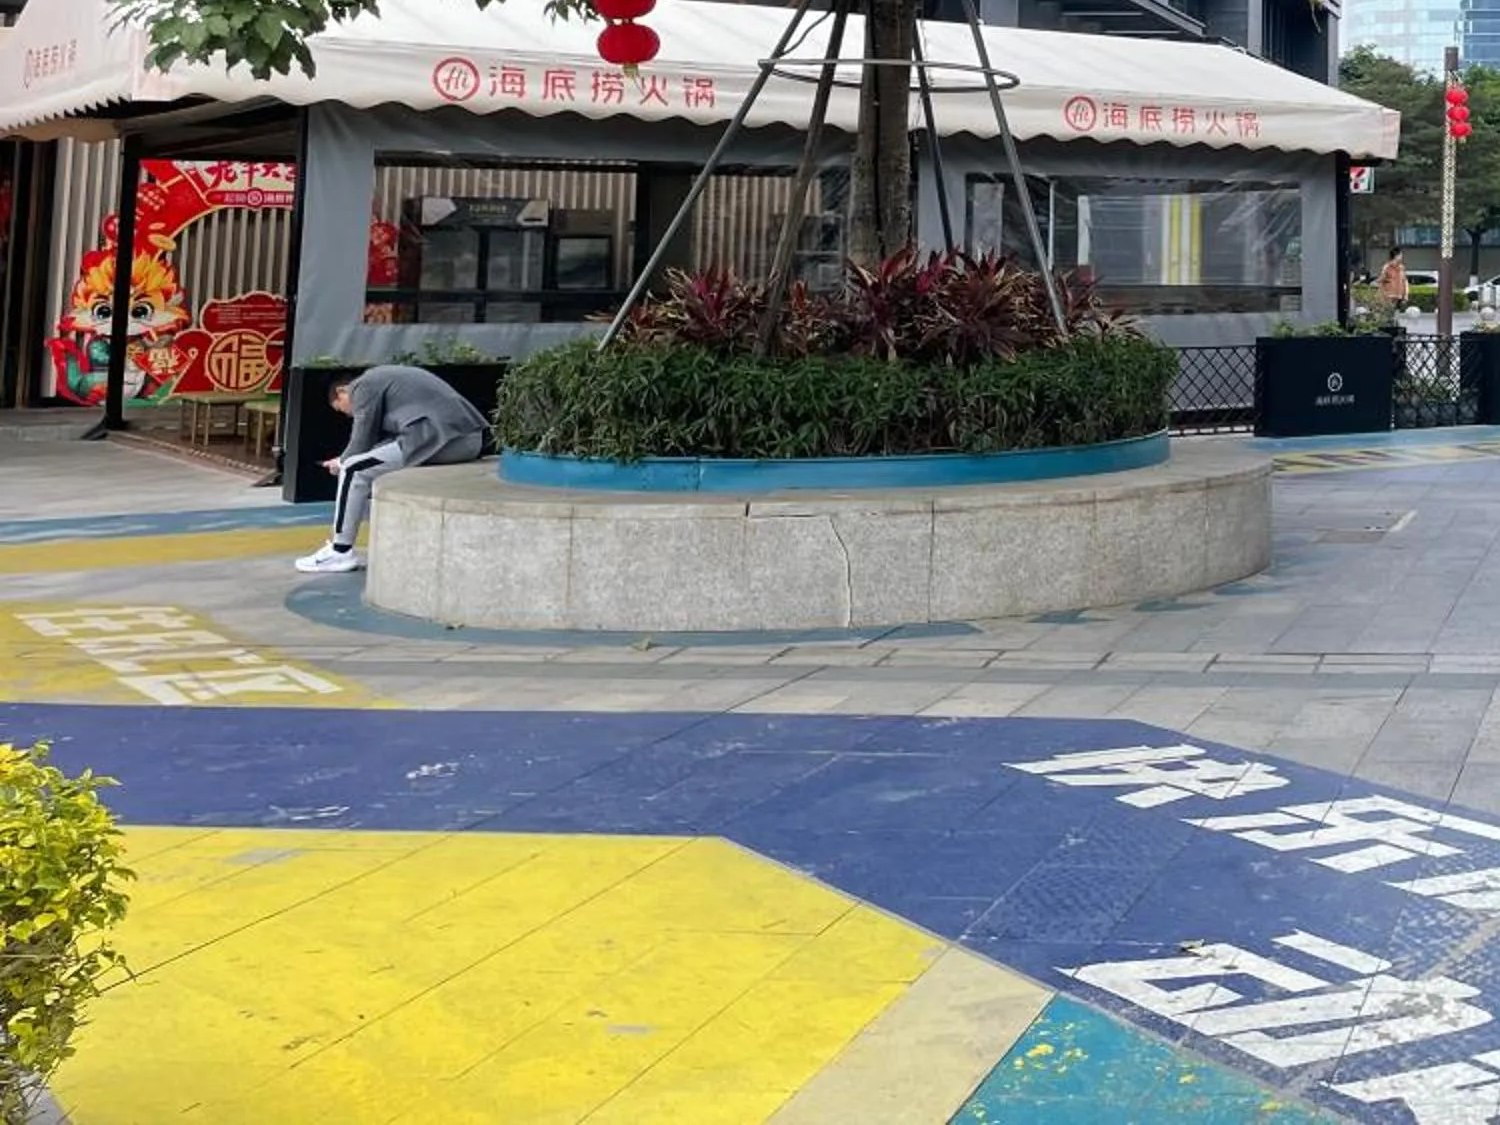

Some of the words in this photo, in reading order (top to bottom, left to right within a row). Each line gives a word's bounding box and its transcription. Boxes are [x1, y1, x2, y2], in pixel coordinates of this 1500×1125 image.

[488, 64, 718, 109] 海底捞火锅
[1103, 101, 1261, 138] 海底捞火锅
